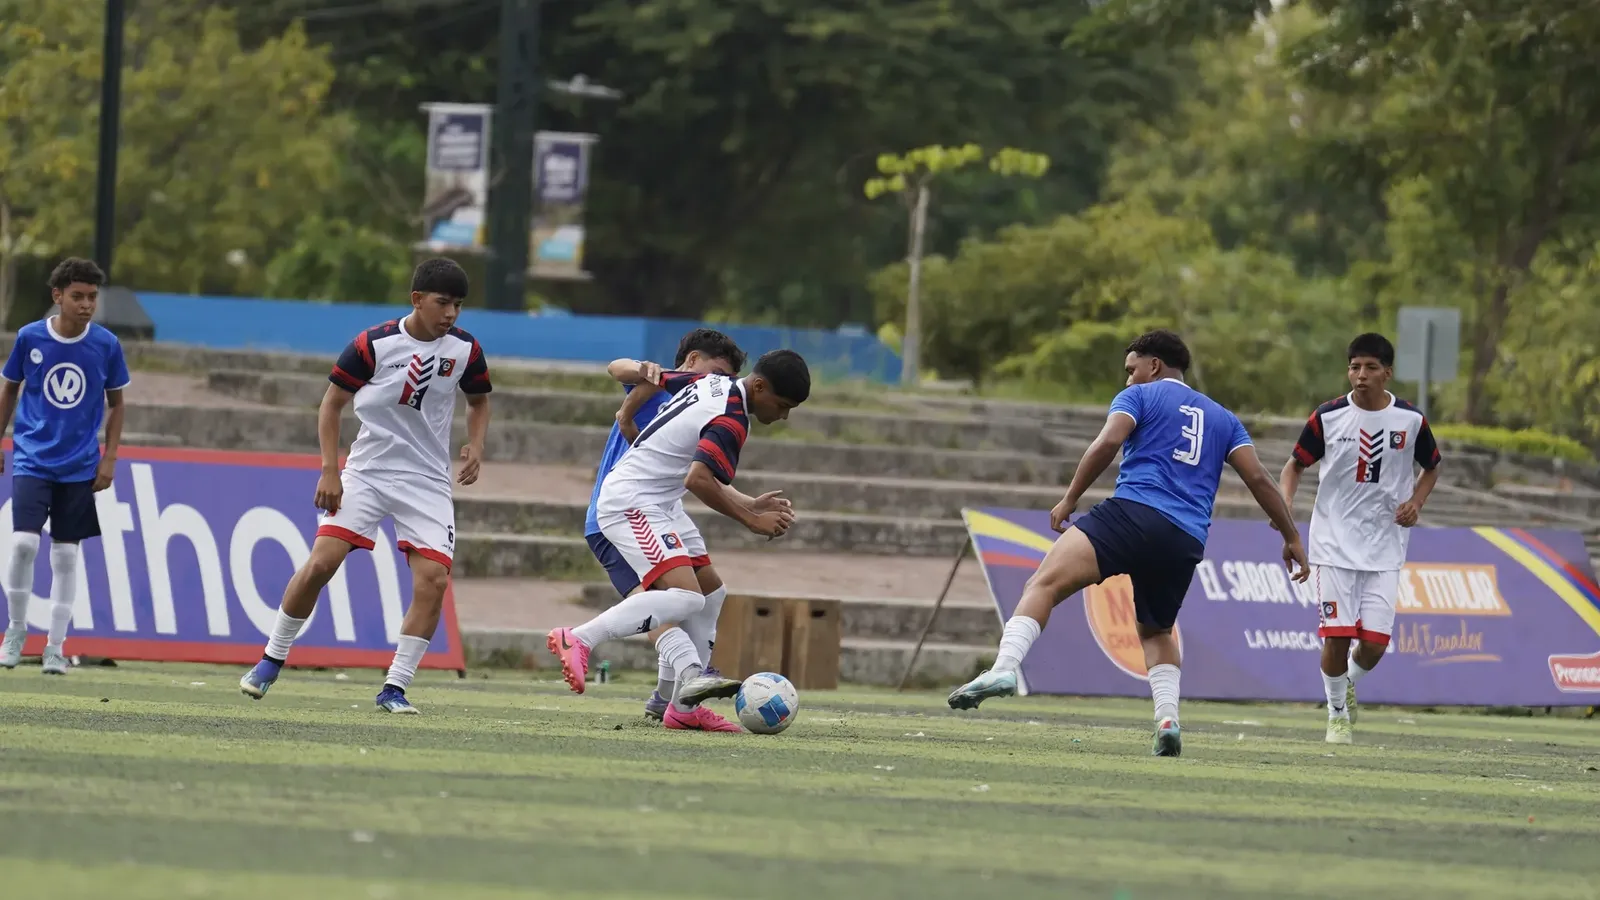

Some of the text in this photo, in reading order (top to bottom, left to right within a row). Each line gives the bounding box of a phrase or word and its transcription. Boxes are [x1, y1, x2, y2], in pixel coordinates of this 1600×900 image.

[407, 391, 420, 407] 6
[1172, 404, 1205, 467] 3
[1222, 560, 1294, 605] SABOR
[1416, 568, 1502, 611] TITULAR
[1244, 628, 1322, 651] LA MARCA
